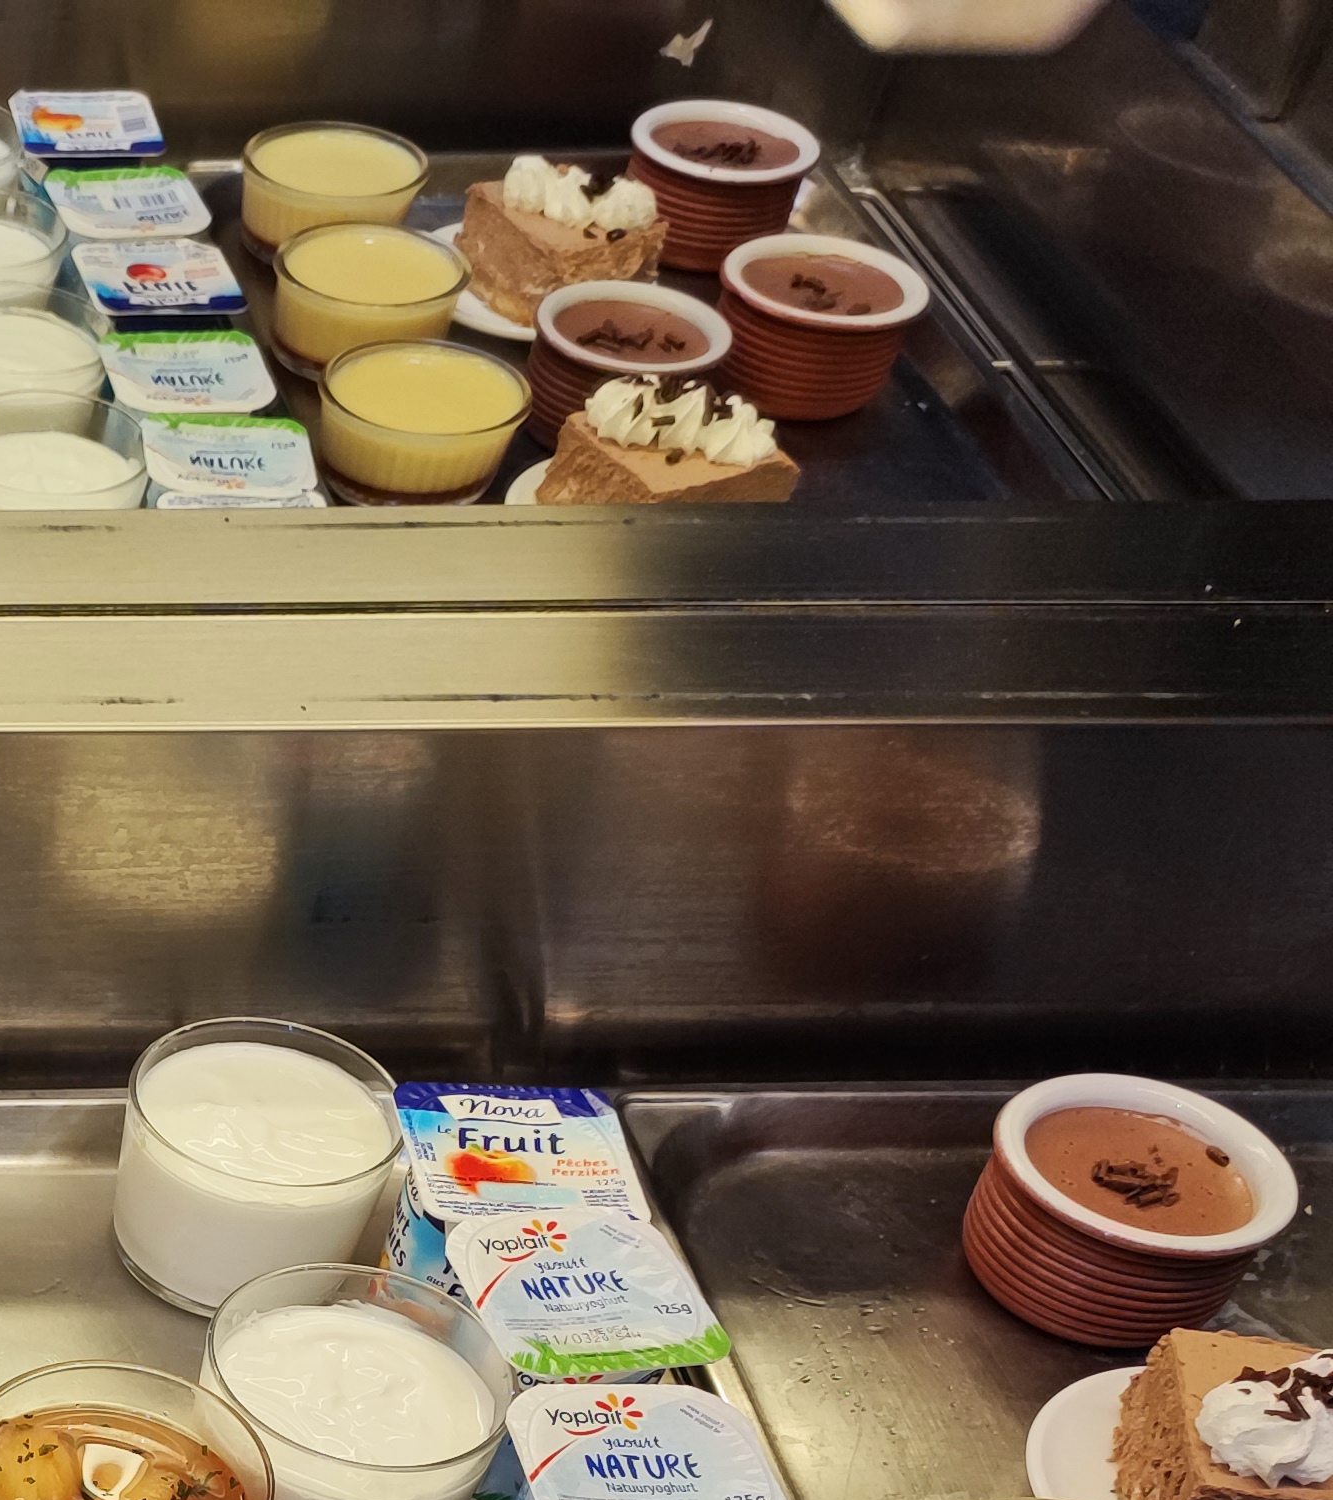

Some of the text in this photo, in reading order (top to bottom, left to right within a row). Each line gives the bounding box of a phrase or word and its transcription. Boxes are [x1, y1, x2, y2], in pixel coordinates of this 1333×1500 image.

[460, 1097, 545, 1121] Nova
[458, 1127, 566, 1156] Fruit
[552, 1168, 619, 1177] Perziken
[521, 1269, 629, 1301] NATURE
[544, 1295, 629, 1314] Natuuryoghurt
[653, 1303, 693, 1316] 125g
[585, 1453, 702, 1480] NATURE
[607, 1482, 699, 1496] Natuuryoghurt
